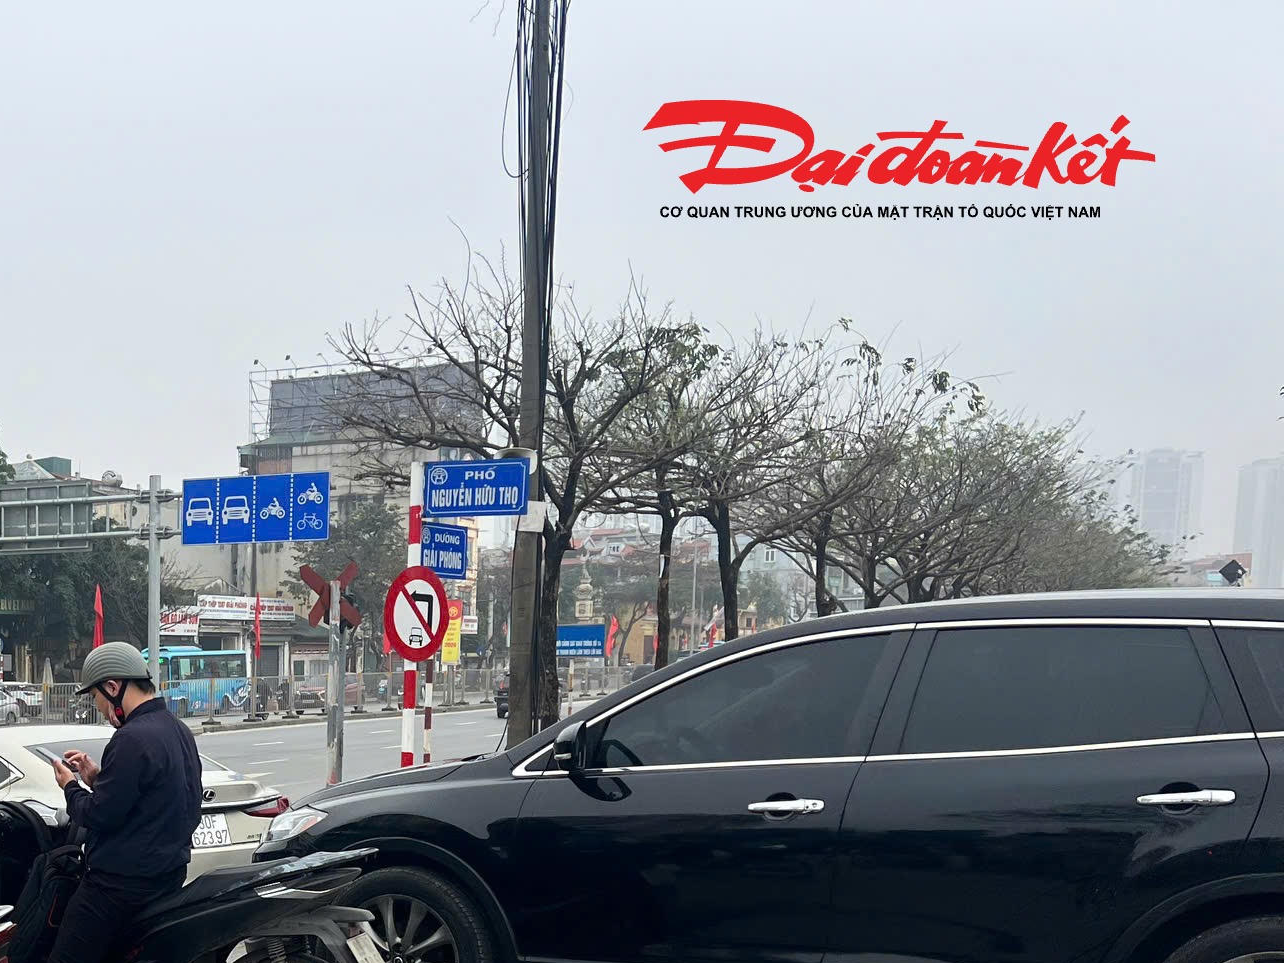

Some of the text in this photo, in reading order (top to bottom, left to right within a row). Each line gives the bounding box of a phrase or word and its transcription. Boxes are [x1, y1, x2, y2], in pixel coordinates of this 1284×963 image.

[464, 466, 497, 480] PHỐ
[431, 483, 519, 508] NGUYỄN HỮU THỌ
[423, 543, 462, 569] GIẢI PHÓNG
[192, 829, 228, 846] 623.97
